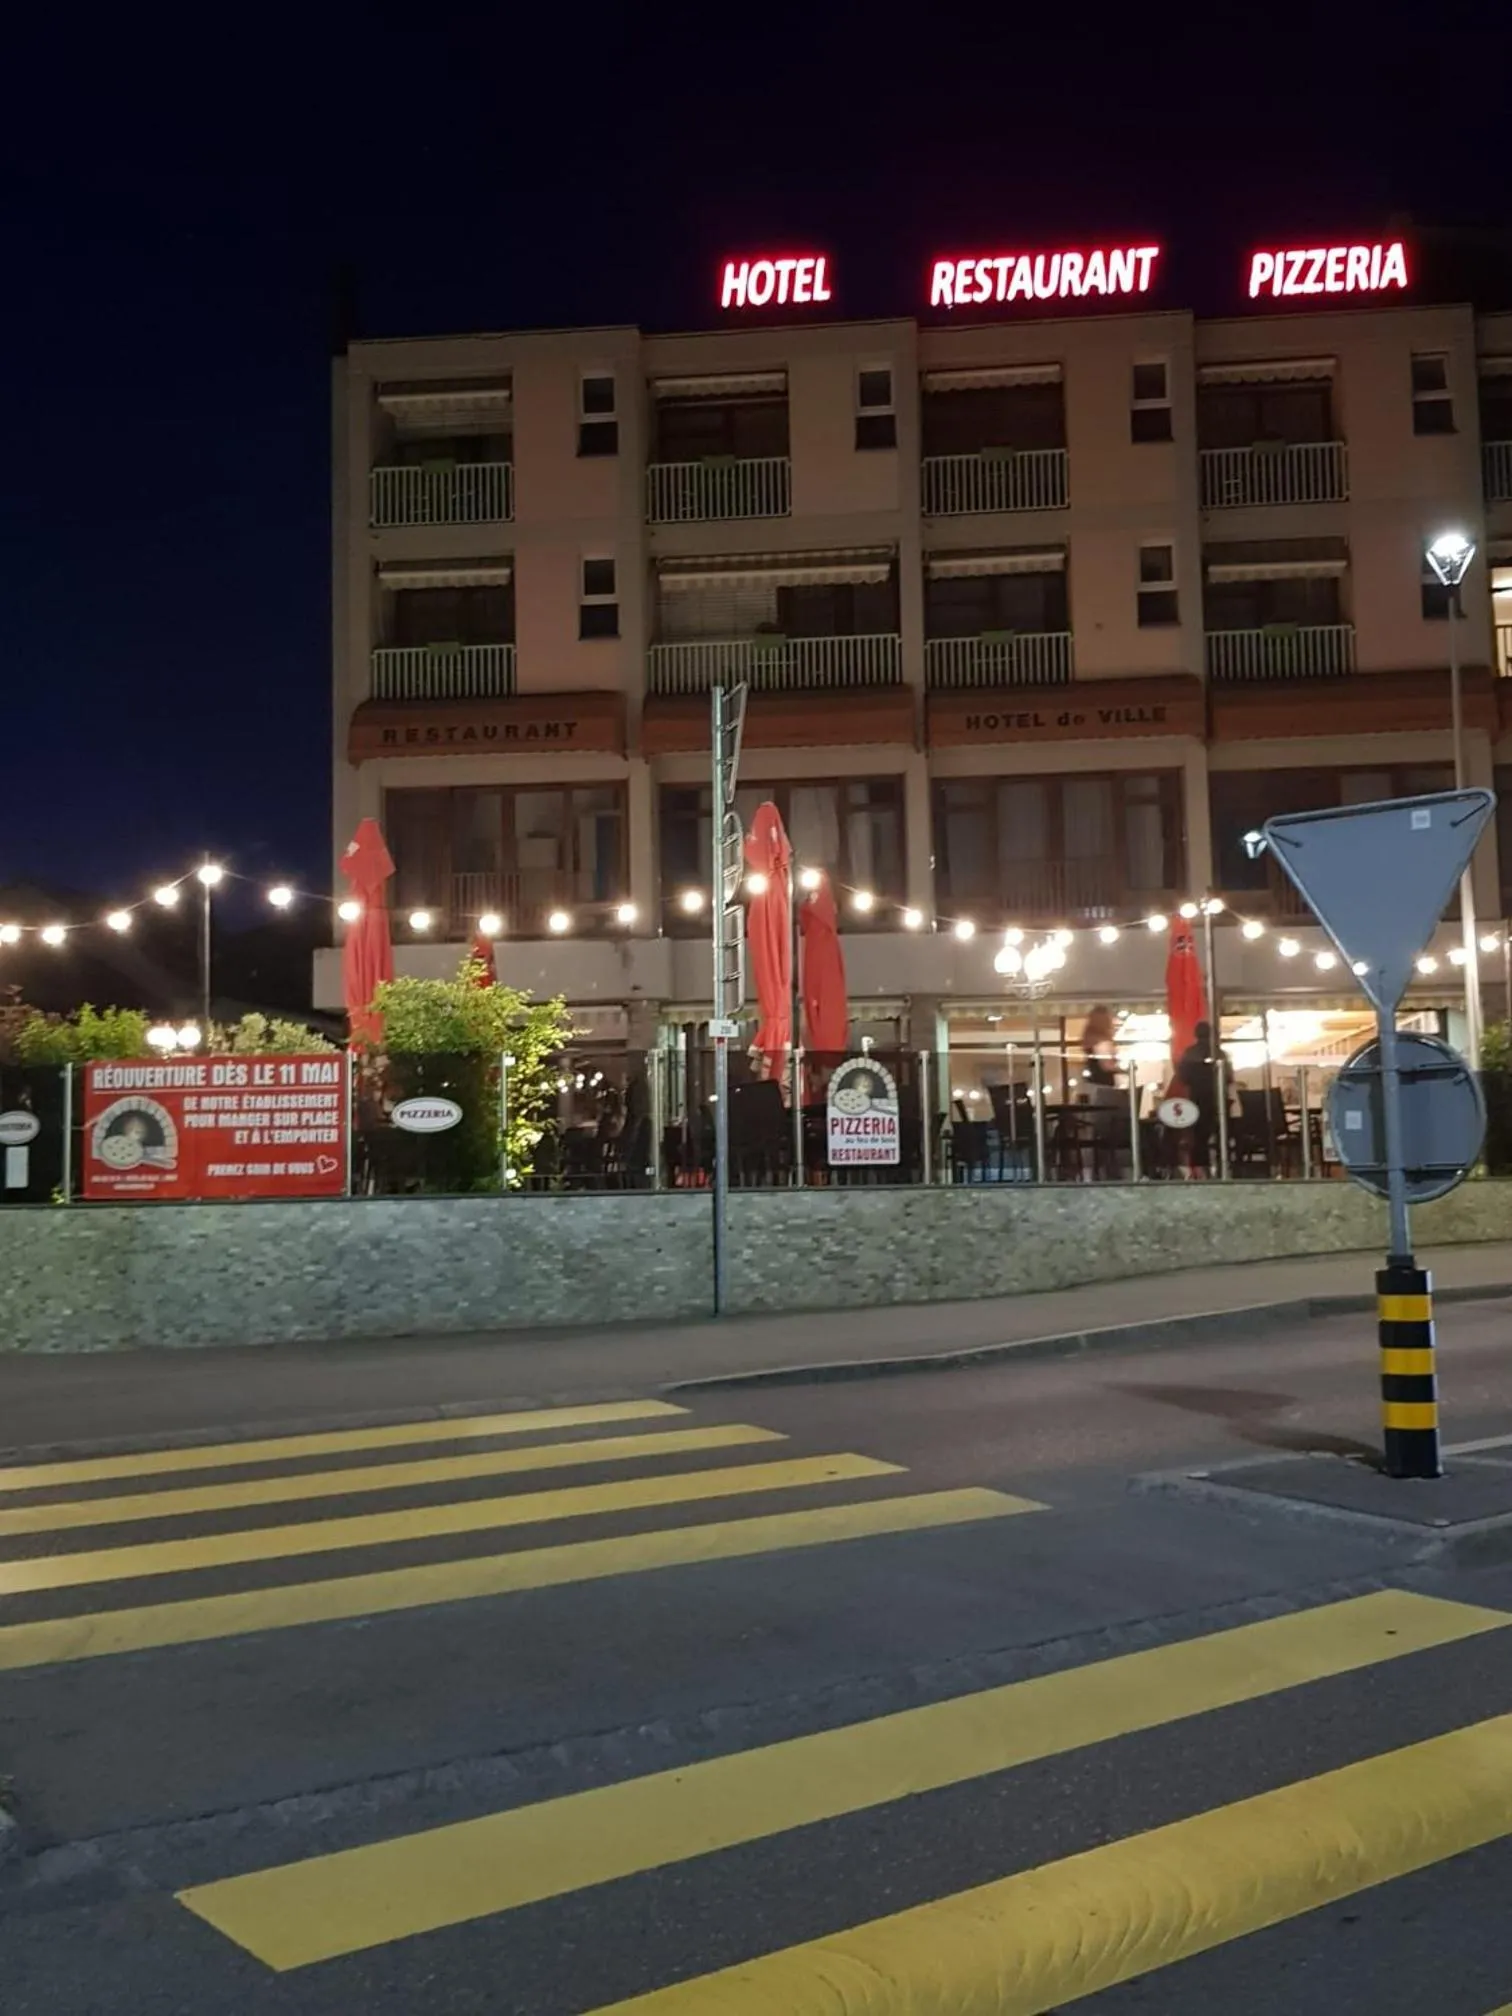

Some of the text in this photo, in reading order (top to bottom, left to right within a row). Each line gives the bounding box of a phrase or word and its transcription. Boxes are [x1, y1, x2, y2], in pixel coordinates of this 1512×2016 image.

[721, 257, 831, 307] HOTEL
[930, 246, 1159, 307] RESTAURANT
[1249, 243, 1408, 298] PIZZERIA
[966, 712, 1046, 730] HOTEL
[1098, 706, 1167, 724] VILLE
[381, 721, 579, 744] RESTAURANT
[93, 1060, 340, 1089] RÉOUVERTURE DÈS LE 11 MAI
[273, 1111, 299, 1126] SUR
[301, 1110, 339, 1126] PLACE
[400, 1109, 454, 1119] PIZZERIA
[235, 1130, 249, 1144] ET
[830, 1117, 897, 1136] PIZZERIA
[831, 1148, 897, 1161] RESTAURANT
